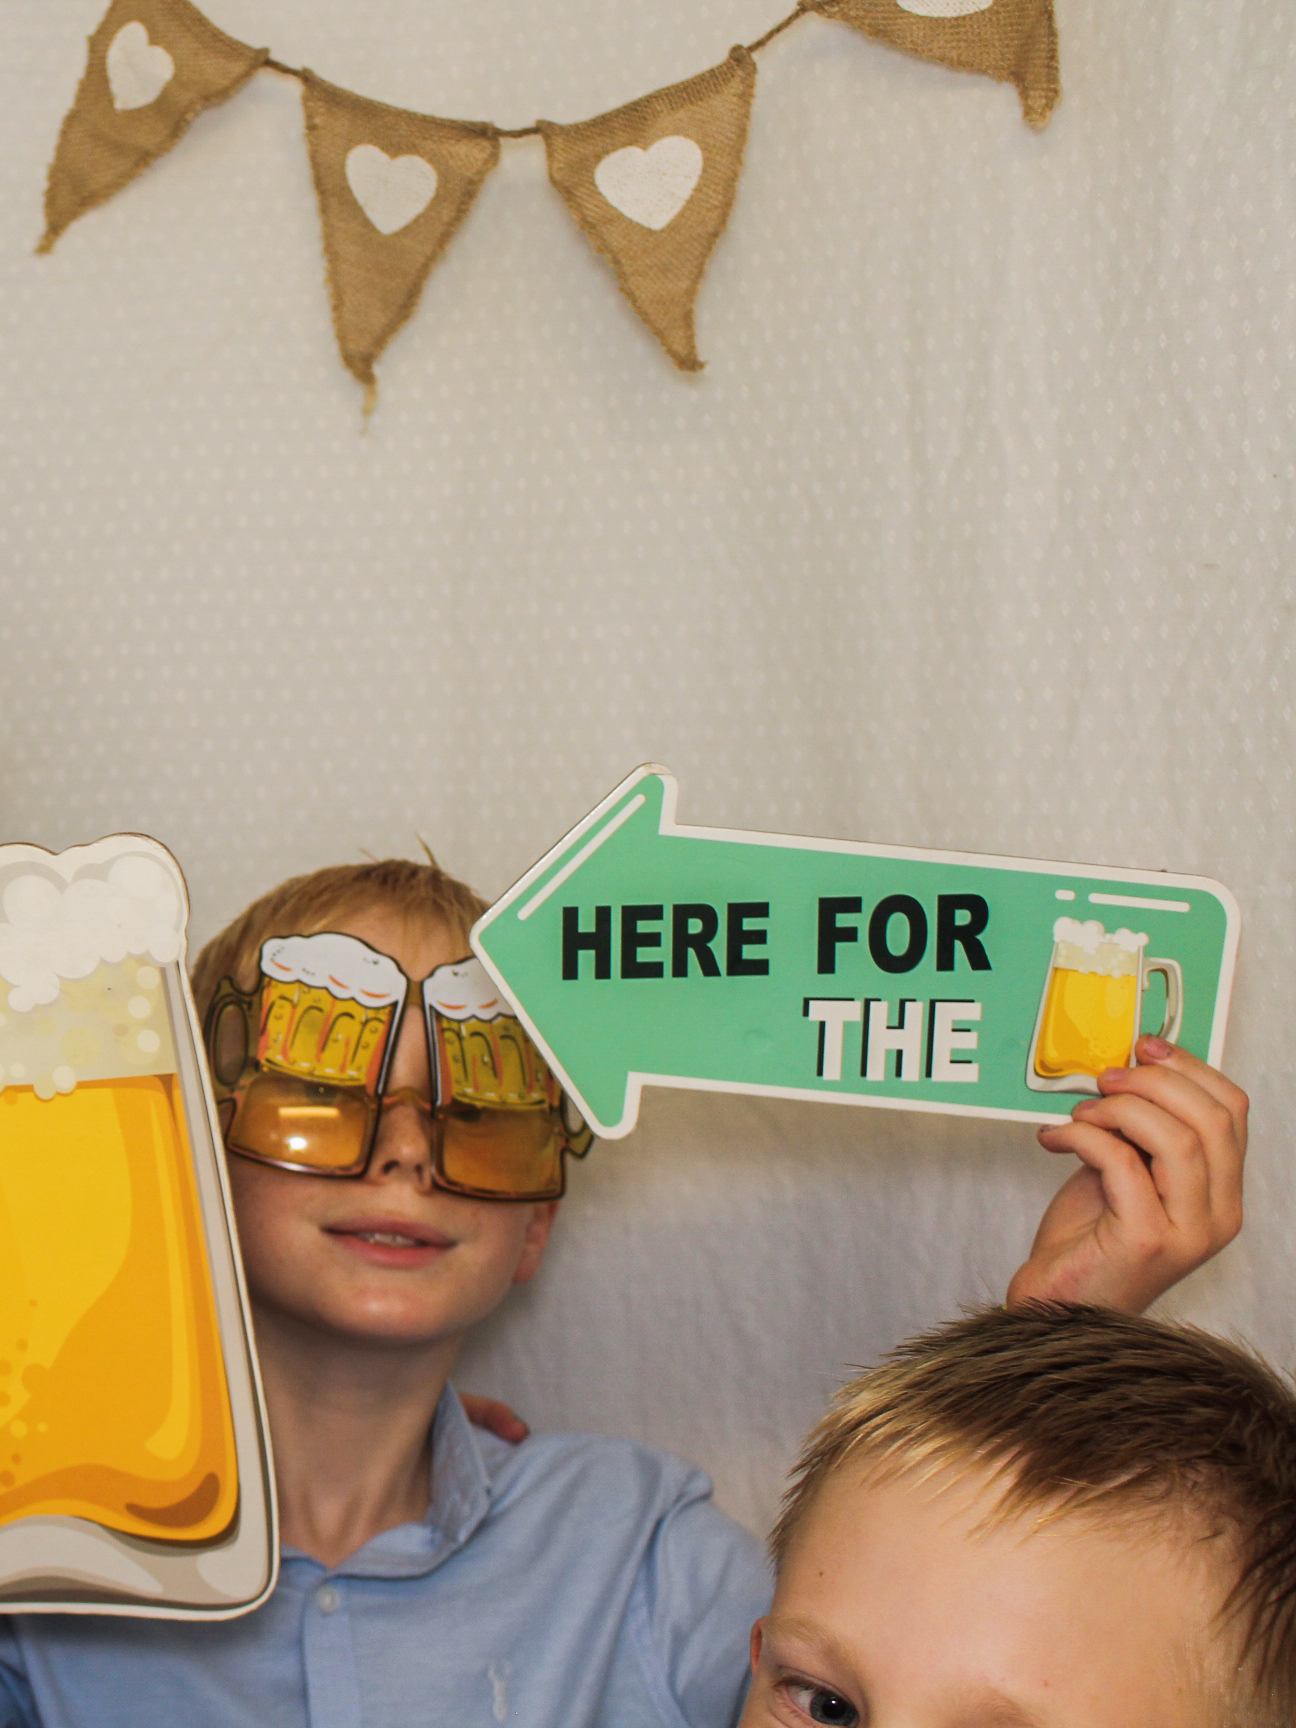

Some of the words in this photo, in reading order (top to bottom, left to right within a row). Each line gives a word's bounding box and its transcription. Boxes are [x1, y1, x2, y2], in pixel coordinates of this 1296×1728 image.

[562, 902, 769, 980] HERE
[817, 894, 992, 974] FOR
[803, 997, 982, 1083] THE
